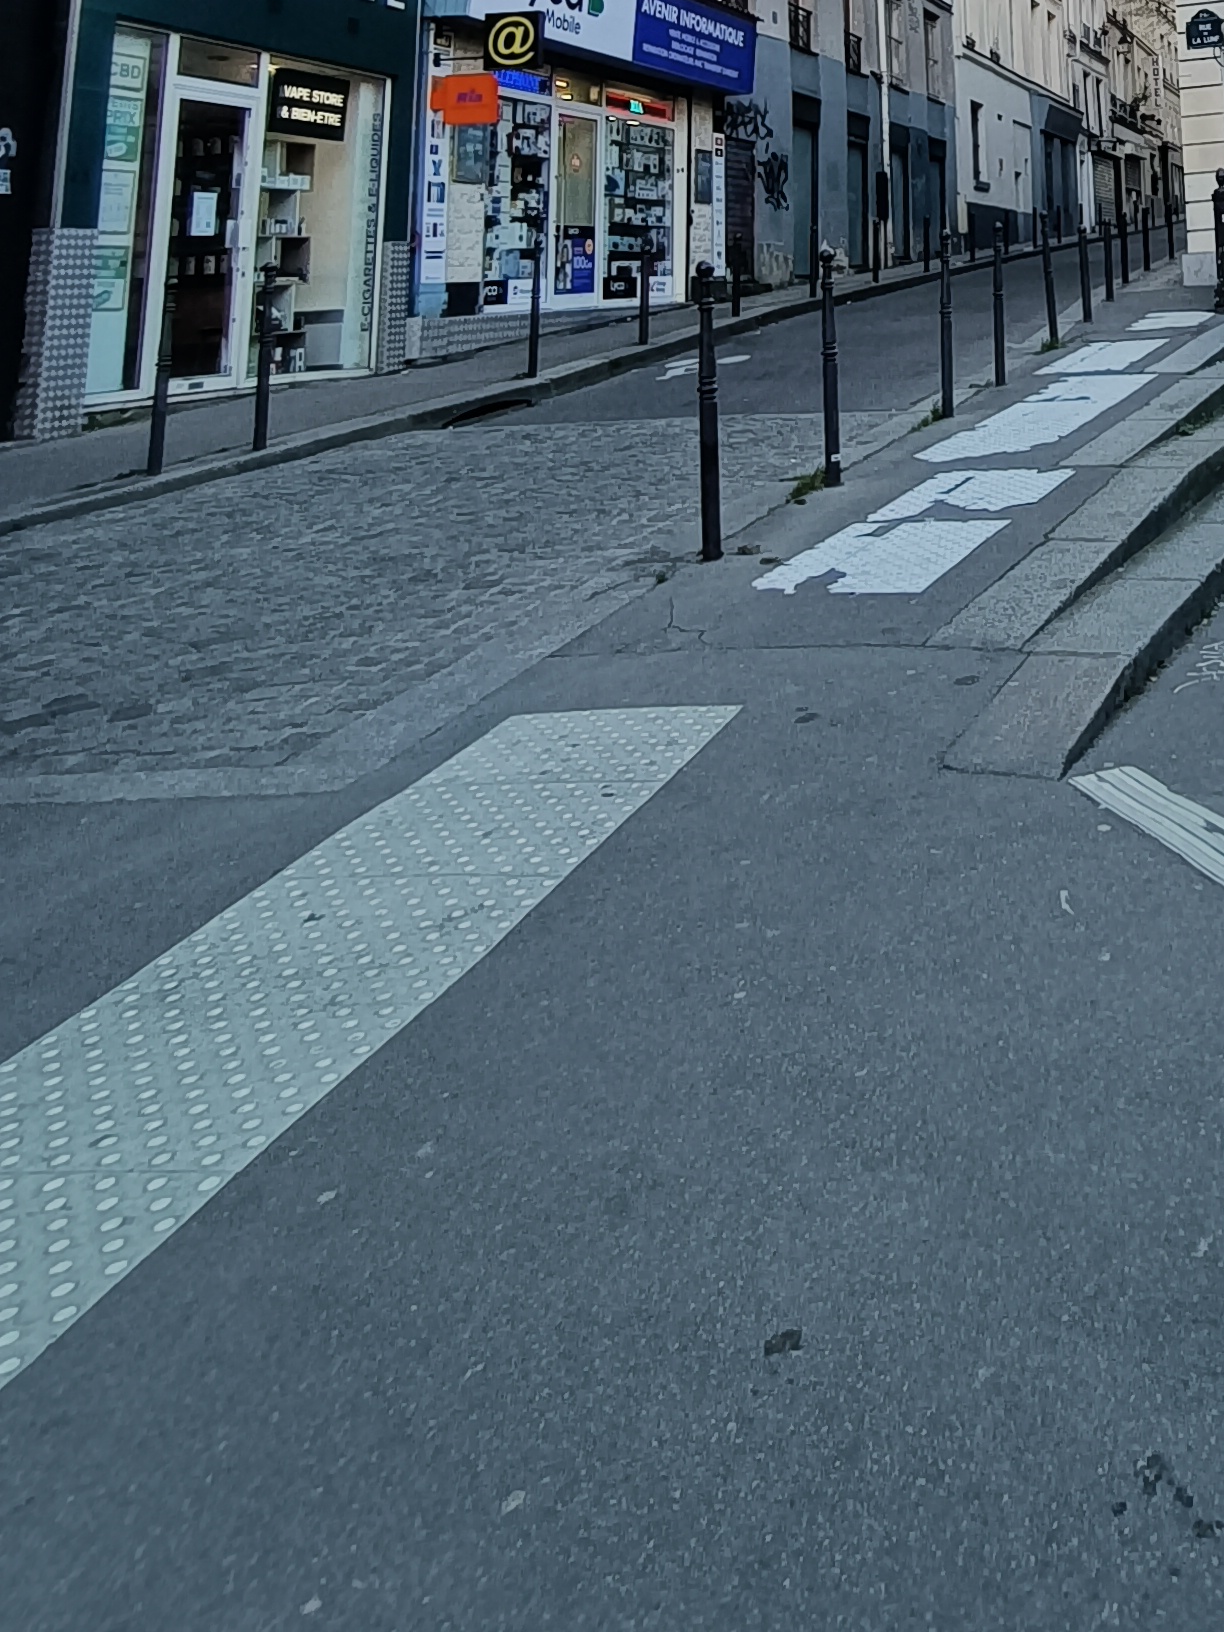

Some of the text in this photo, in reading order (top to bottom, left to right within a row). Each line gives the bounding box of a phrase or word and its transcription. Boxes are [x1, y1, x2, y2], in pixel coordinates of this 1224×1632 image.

[546, 8, 581, 35] Mobile
[680, 8, 745, 48] INFORMATIQUE
[283, 84, 345, 108] VAPE STORE
[1152, 57, 1161, 107] HOTEL
[360, 219, 375, 332] E-CIGARETTES
[368, 113, 382, 198] E-LIQUIDES
